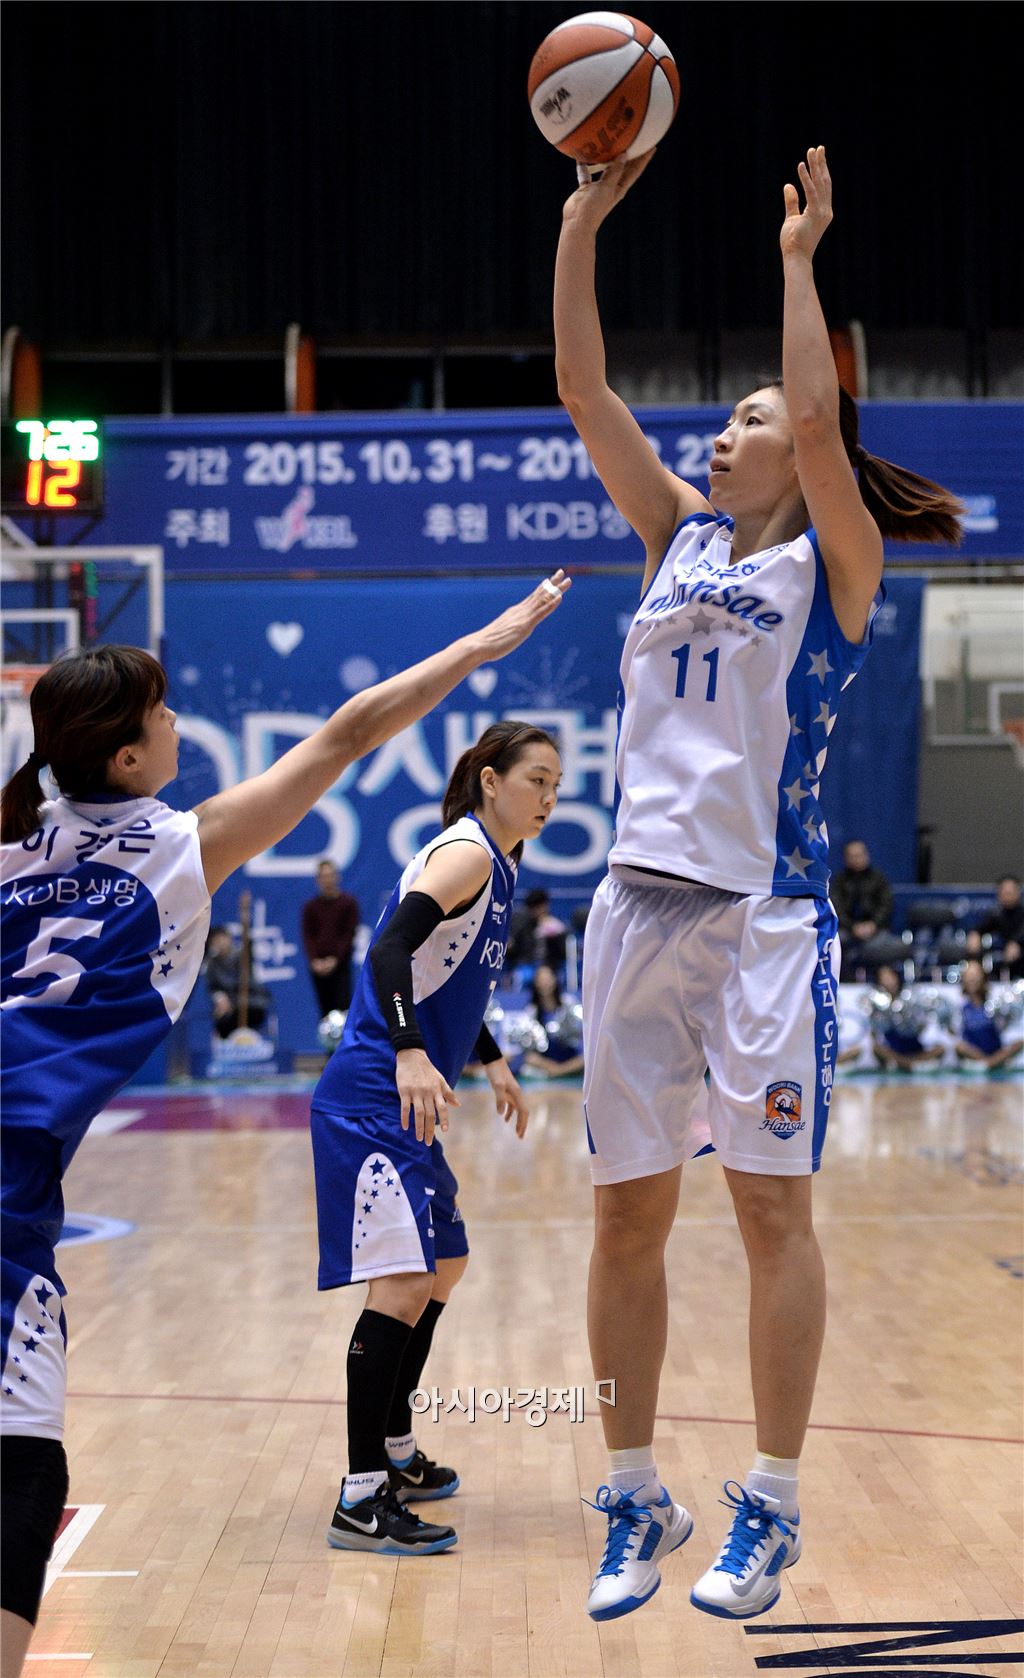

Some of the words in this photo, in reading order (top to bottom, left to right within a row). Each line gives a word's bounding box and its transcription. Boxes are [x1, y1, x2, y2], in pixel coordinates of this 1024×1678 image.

[26, 460, 82, 506] 12
[165, 446, 231, 486] 기간
[506, 501, 634, 541] KDB생
[671, 643, 720, 702] 11
[22, 818, 156, 865] 이경은
[4, 877, 139, 907] KDB생명
[0, 916, 105, 1010] 5
[758, 1117, 806, 1131] Hansae
